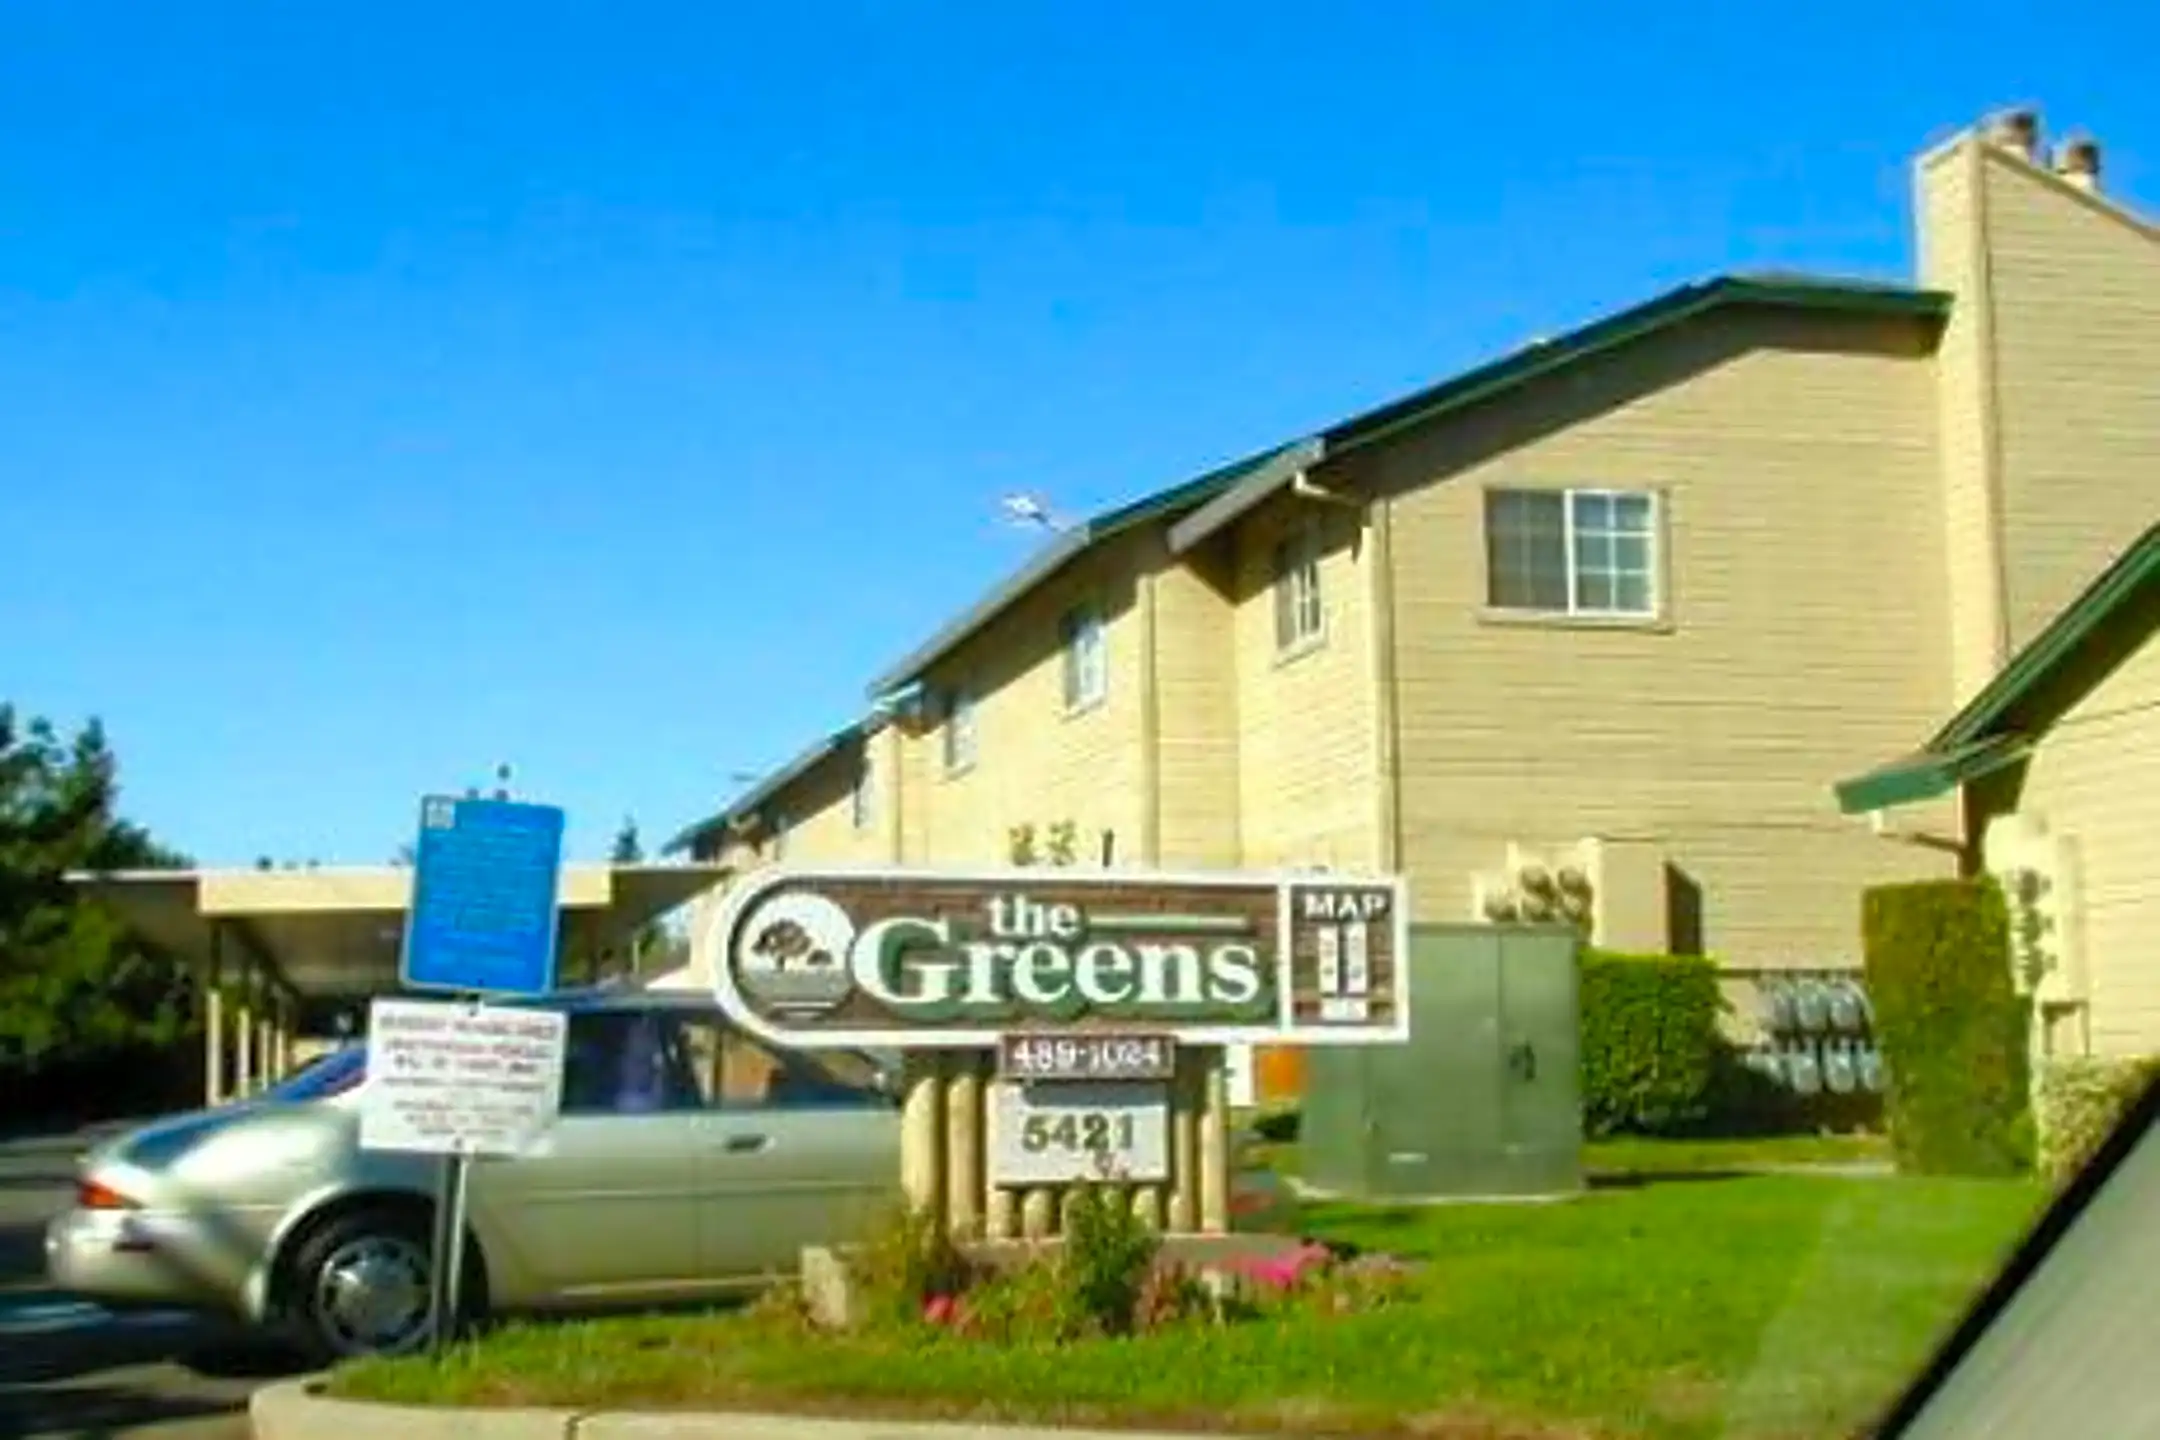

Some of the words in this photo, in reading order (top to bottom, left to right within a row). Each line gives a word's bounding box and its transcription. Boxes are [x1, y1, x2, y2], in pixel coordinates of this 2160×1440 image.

[990, 893, 1082, 937] the
[1305, 893, 1387, 919] MAP
[853, 917, 1260, 1005] Greens
[1021, 1113, 1134, 1153] 5421
